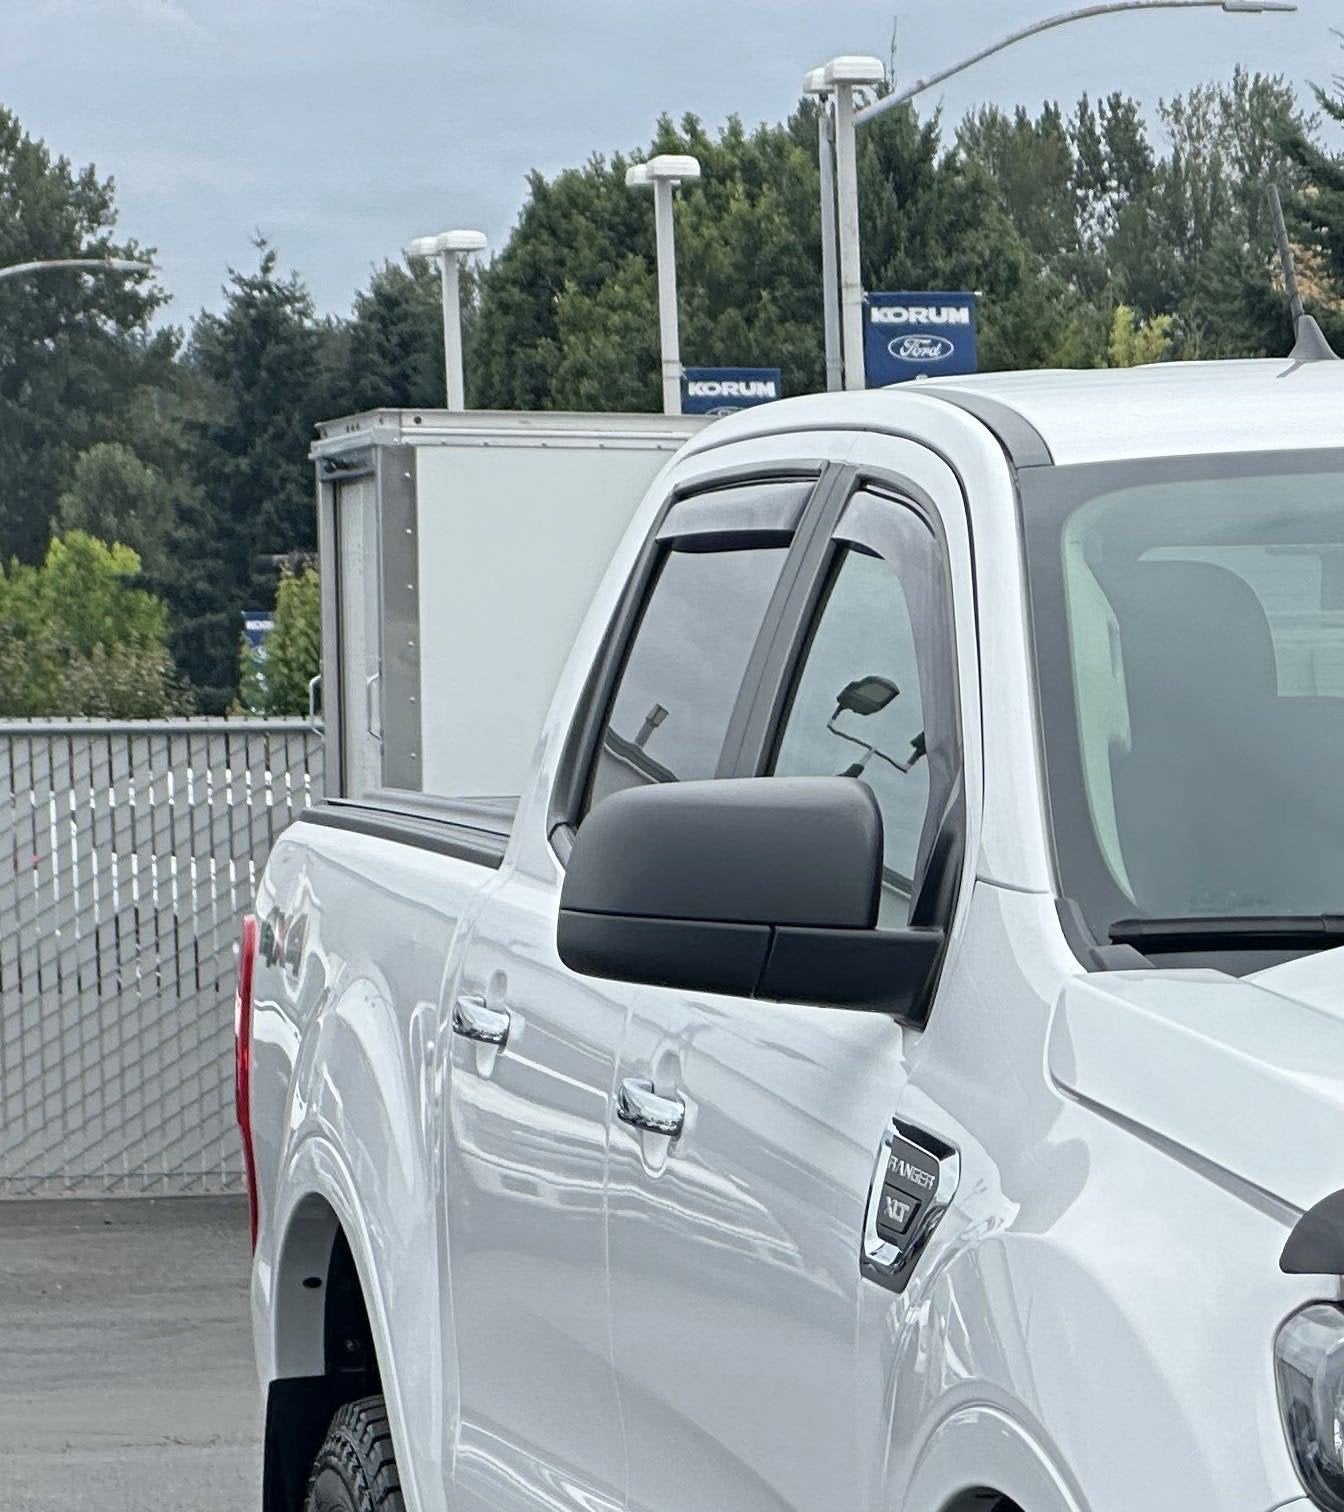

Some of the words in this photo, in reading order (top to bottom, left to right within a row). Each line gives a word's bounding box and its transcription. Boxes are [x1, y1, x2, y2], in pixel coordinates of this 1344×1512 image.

[870, 306, 970, 325] KORUM
[900, 338, 941, 359] Ford
[688, 381, 776, 397] KORUM
[888, 1155, 936, 1191] RANGER
[883, 1195, 910, 1223] XLT
